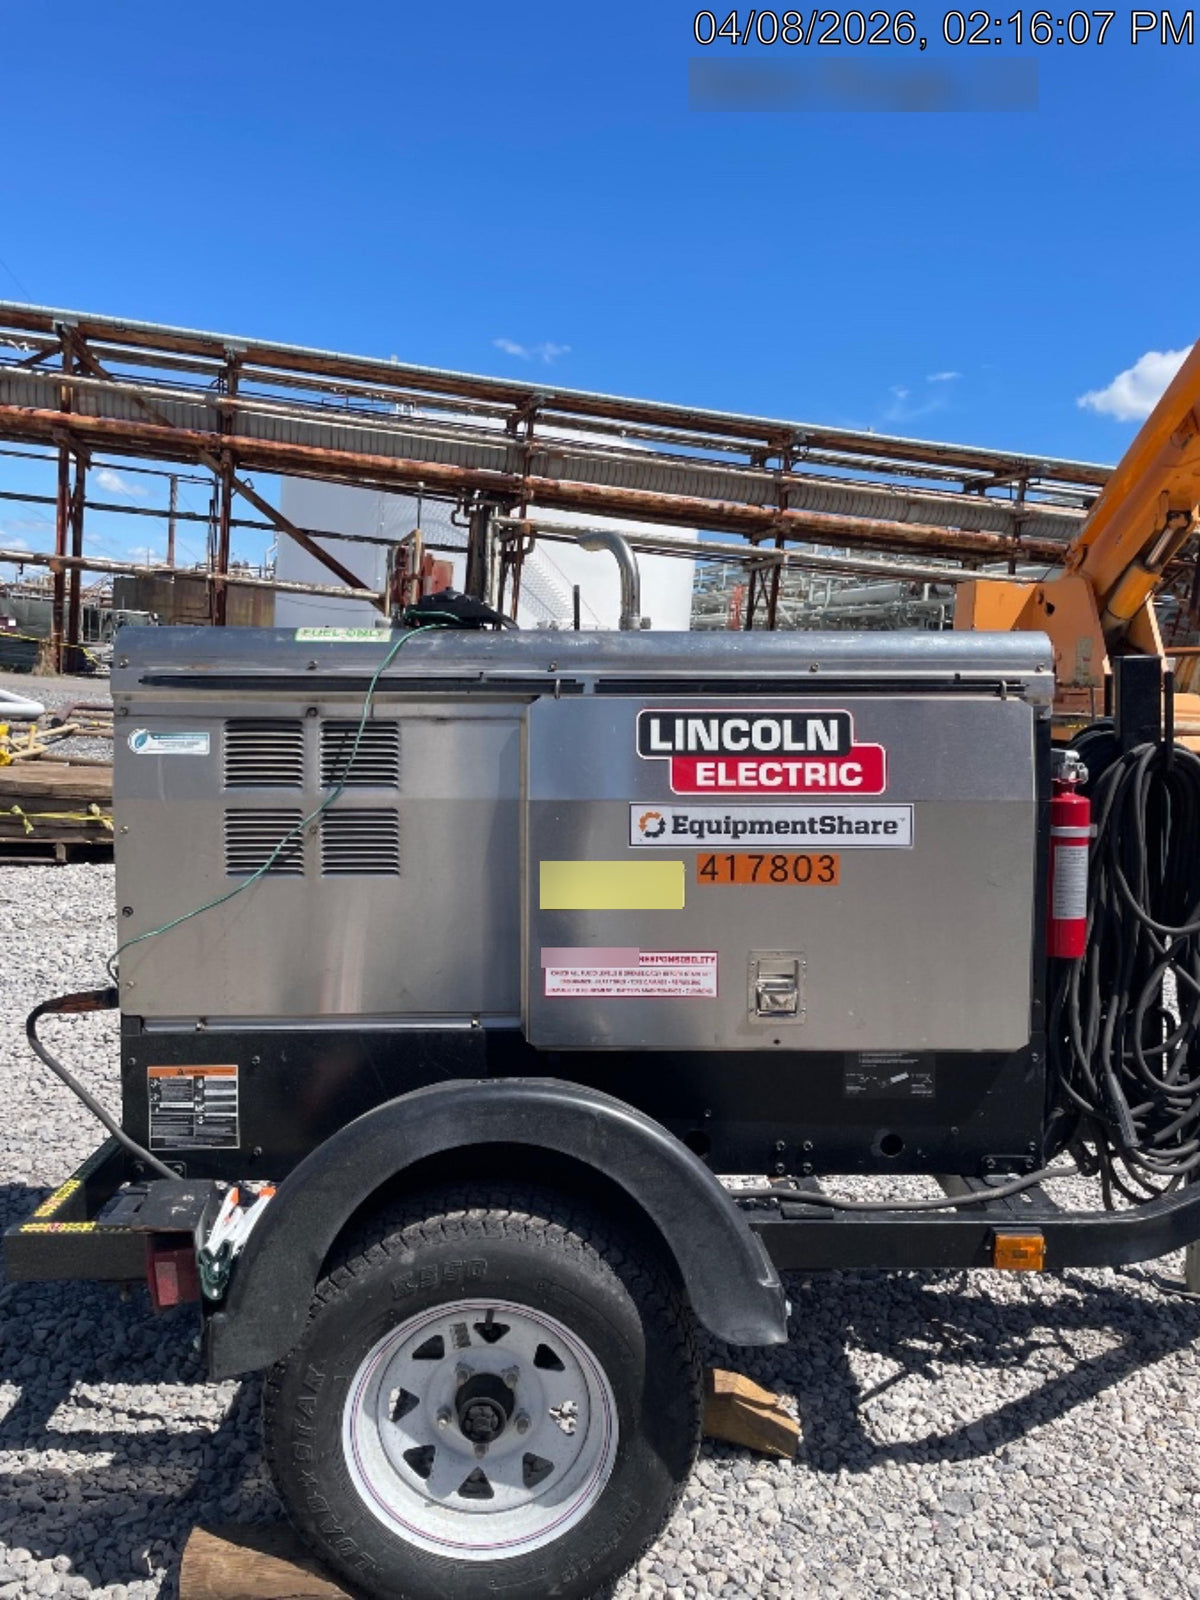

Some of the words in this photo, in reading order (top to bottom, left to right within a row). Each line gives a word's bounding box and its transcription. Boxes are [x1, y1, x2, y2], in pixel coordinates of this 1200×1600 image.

[302, 628, 339, 637] FUEL
[345, 628, 384, 637] ONLY
[650, 719, 838, 751] LINCOLN
[696, 762, 863, 787] ELECTRIC
[672, 816, 898, 839] EquipmentShare
[700, 855, 835, 882] 417803
